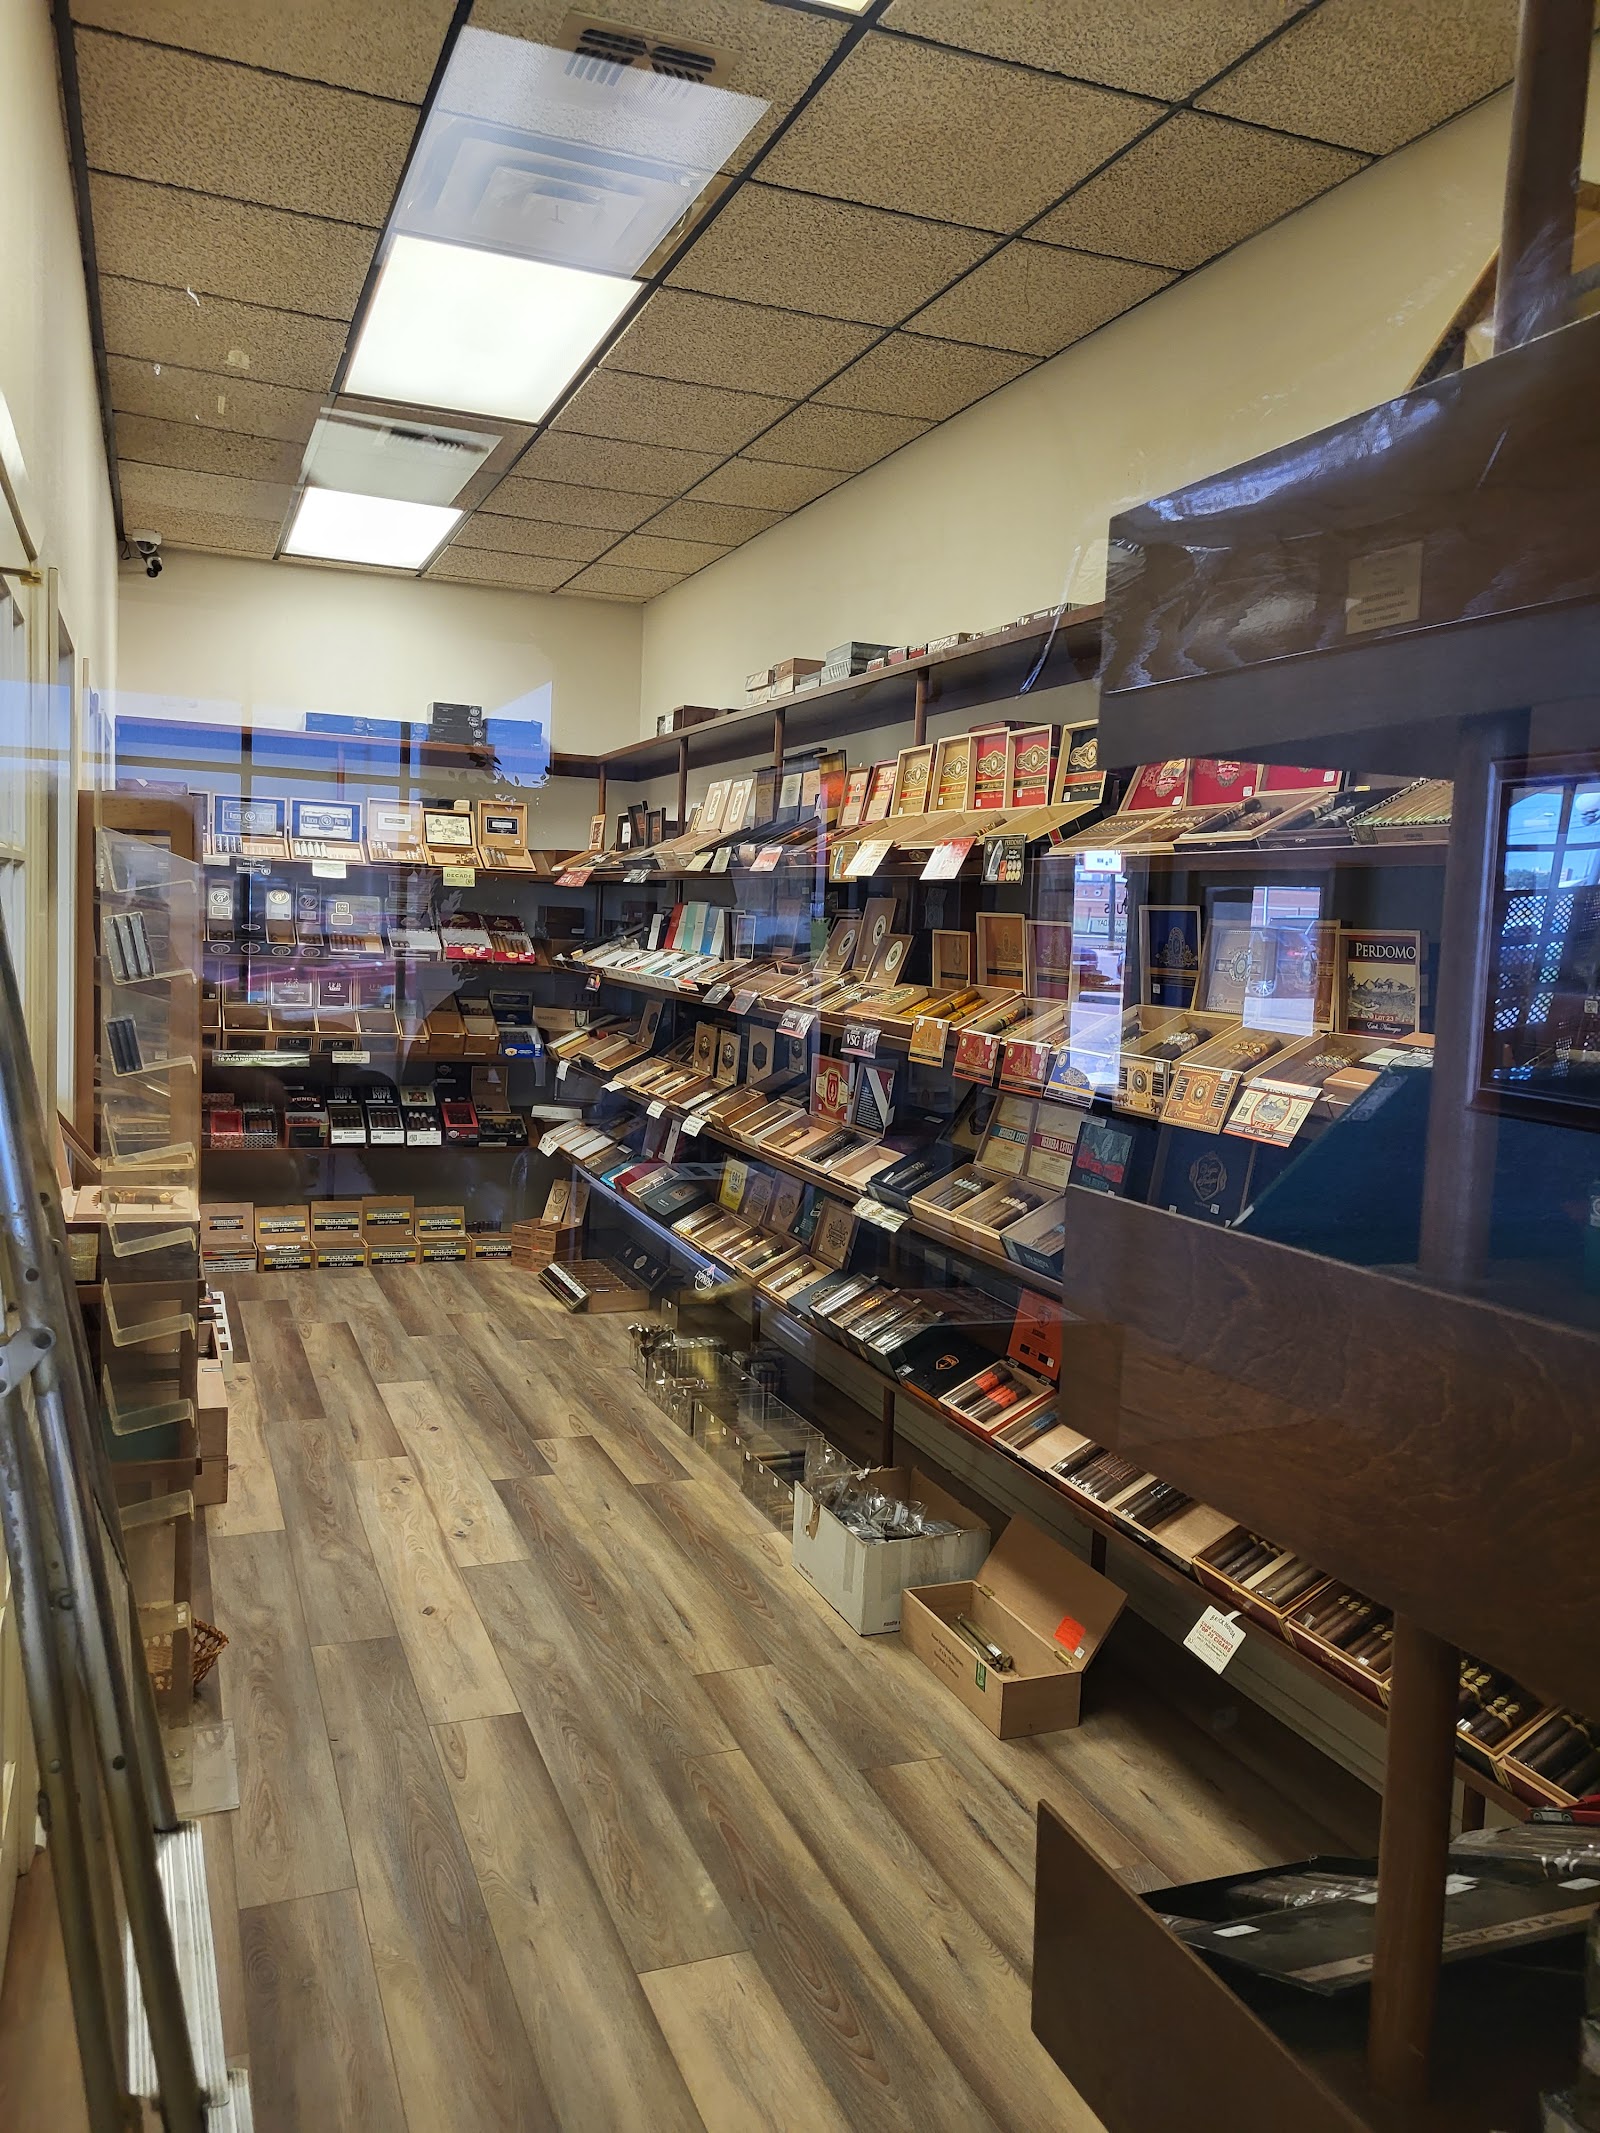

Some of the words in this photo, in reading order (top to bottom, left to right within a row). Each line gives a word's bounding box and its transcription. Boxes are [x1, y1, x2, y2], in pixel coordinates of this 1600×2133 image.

[1355, 942, 1417, 960] PERDOMO
[846, 1033, 861, 1047] VSG
[1209, 1614, 1225, 1626] BRICK
[1223, 1621, 1236, 1639] HOUSE
[1199, 1624, 1209, 1633] TOP
[1213, 1636, 1232, 1653] CIGARS
